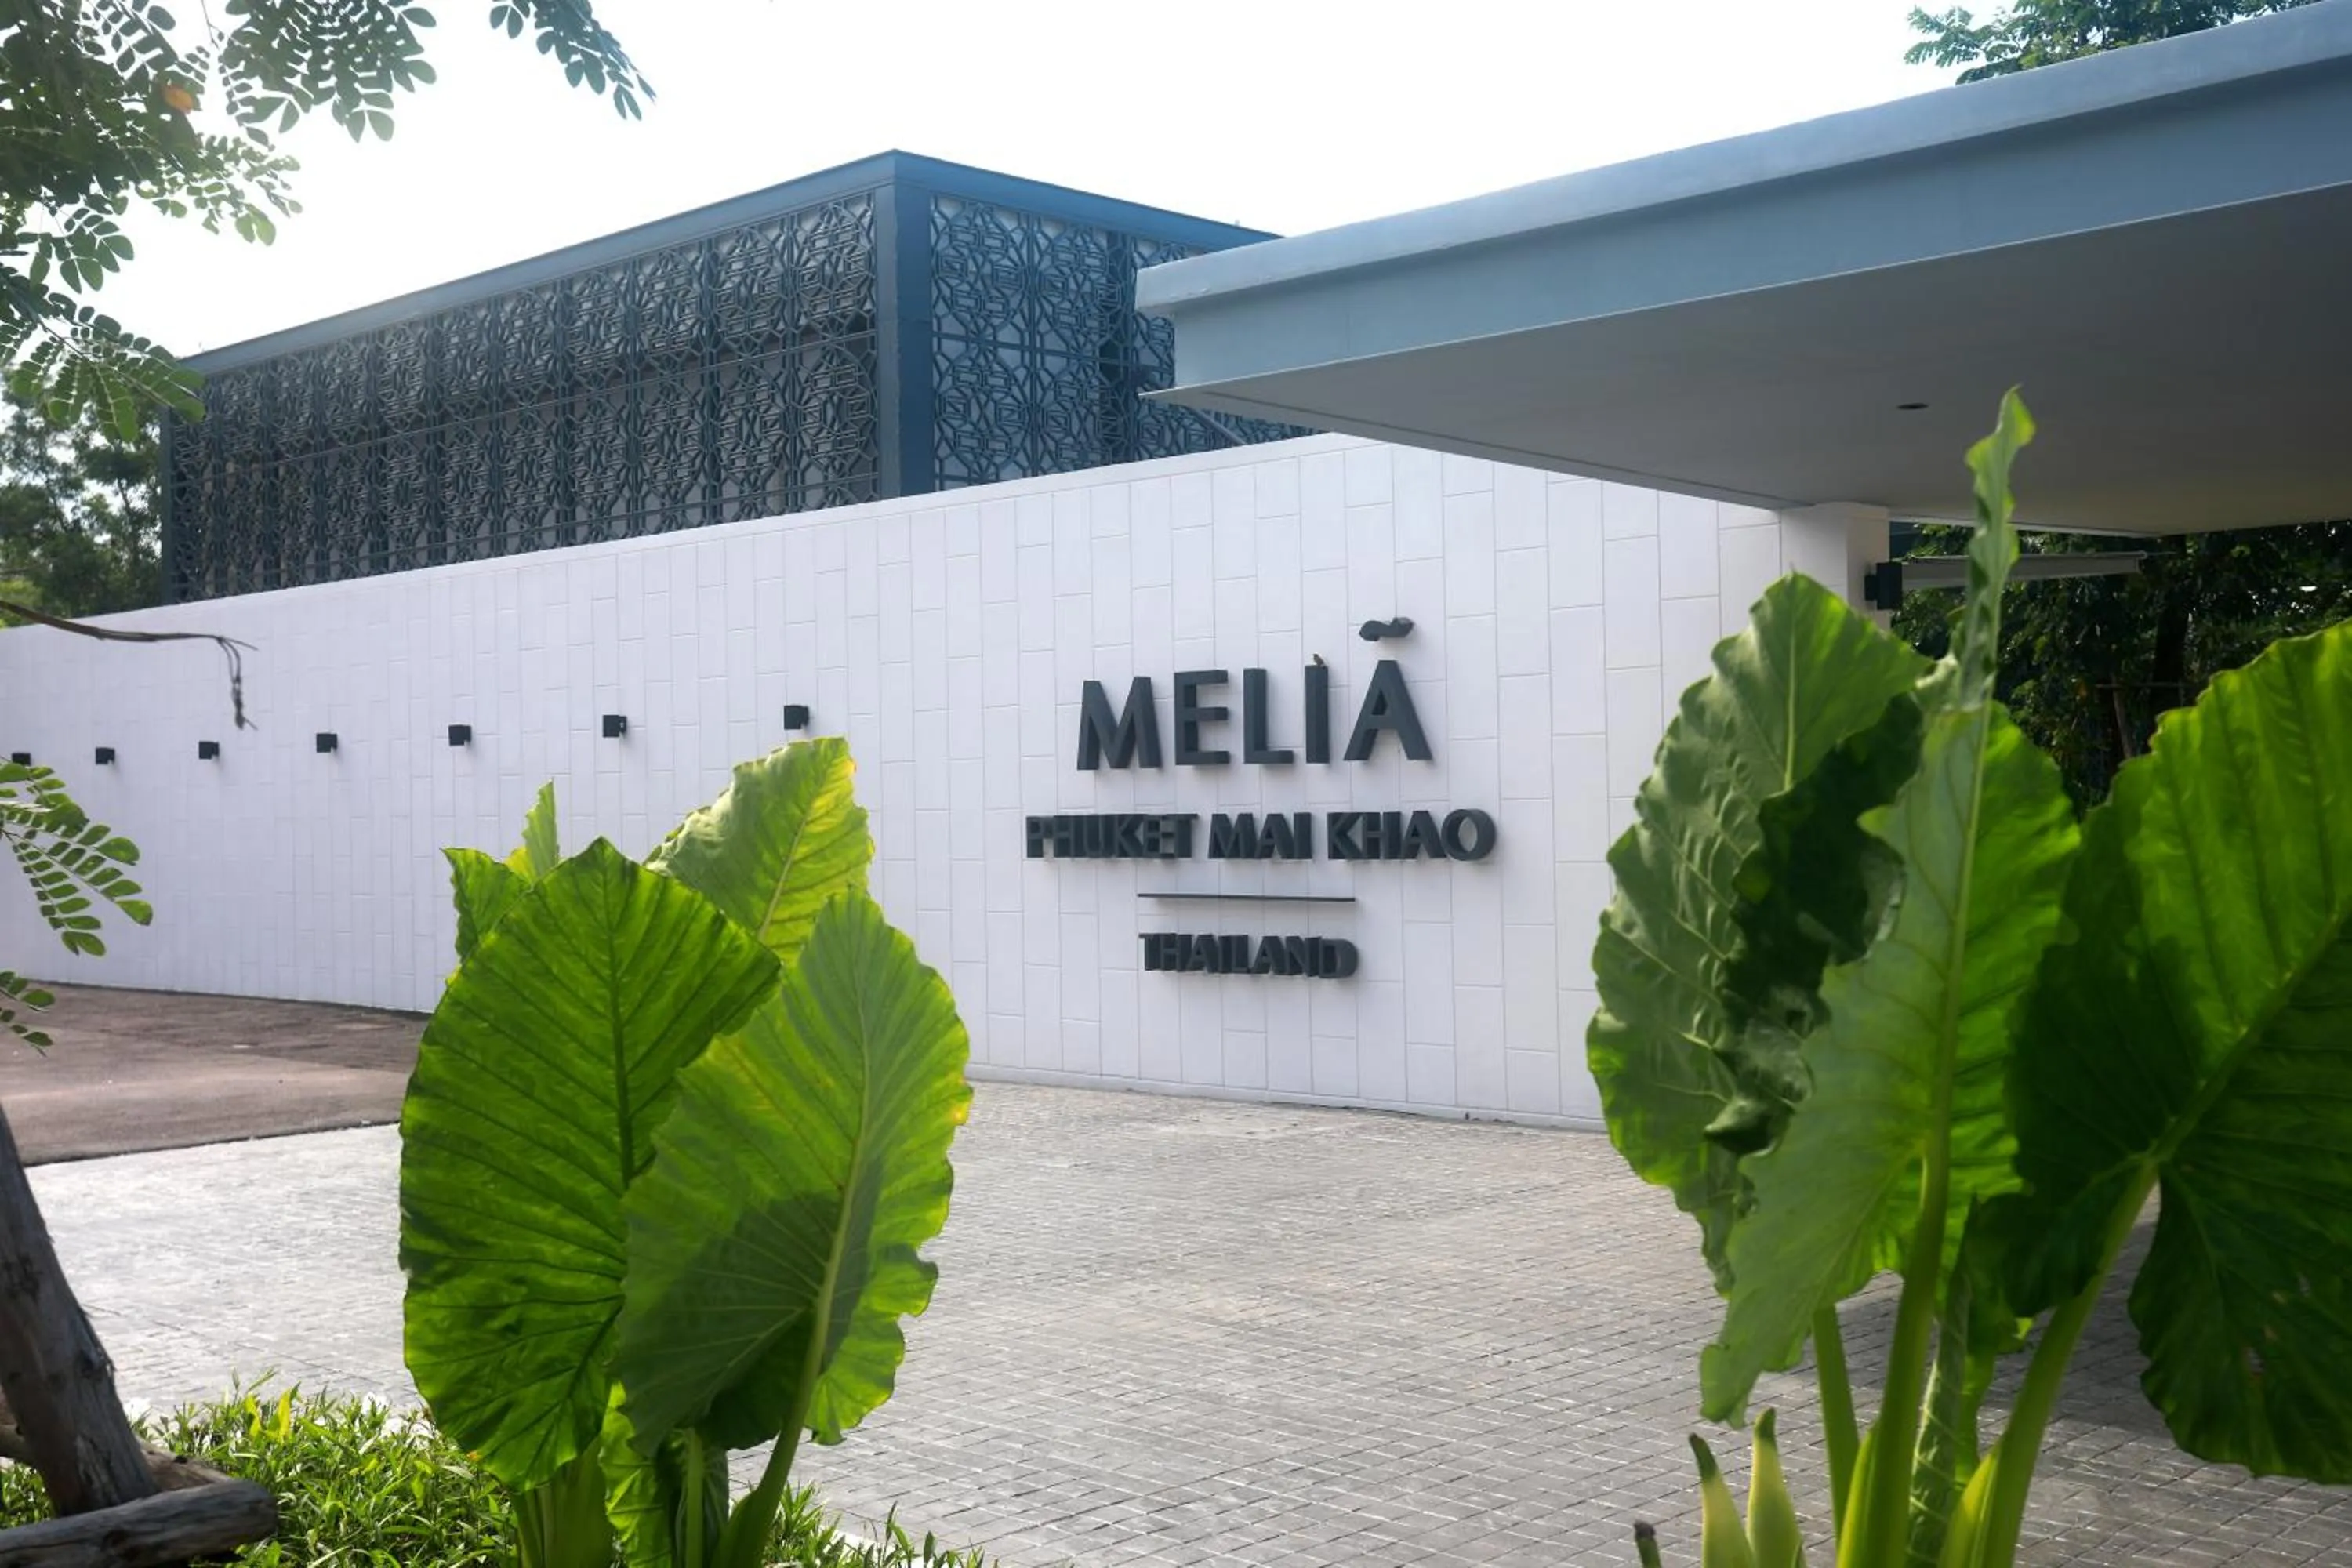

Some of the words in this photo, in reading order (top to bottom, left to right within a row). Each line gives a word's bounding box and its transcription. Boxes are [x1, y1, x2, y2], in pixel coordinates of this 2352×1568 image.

[1025, 813, 1199, 858] PHUKET
[1207, 812, 1312, 860] MAI
[1327, 808, 1497, 862] KHAO
[1138, 932, 1359, 979] THAILAND
